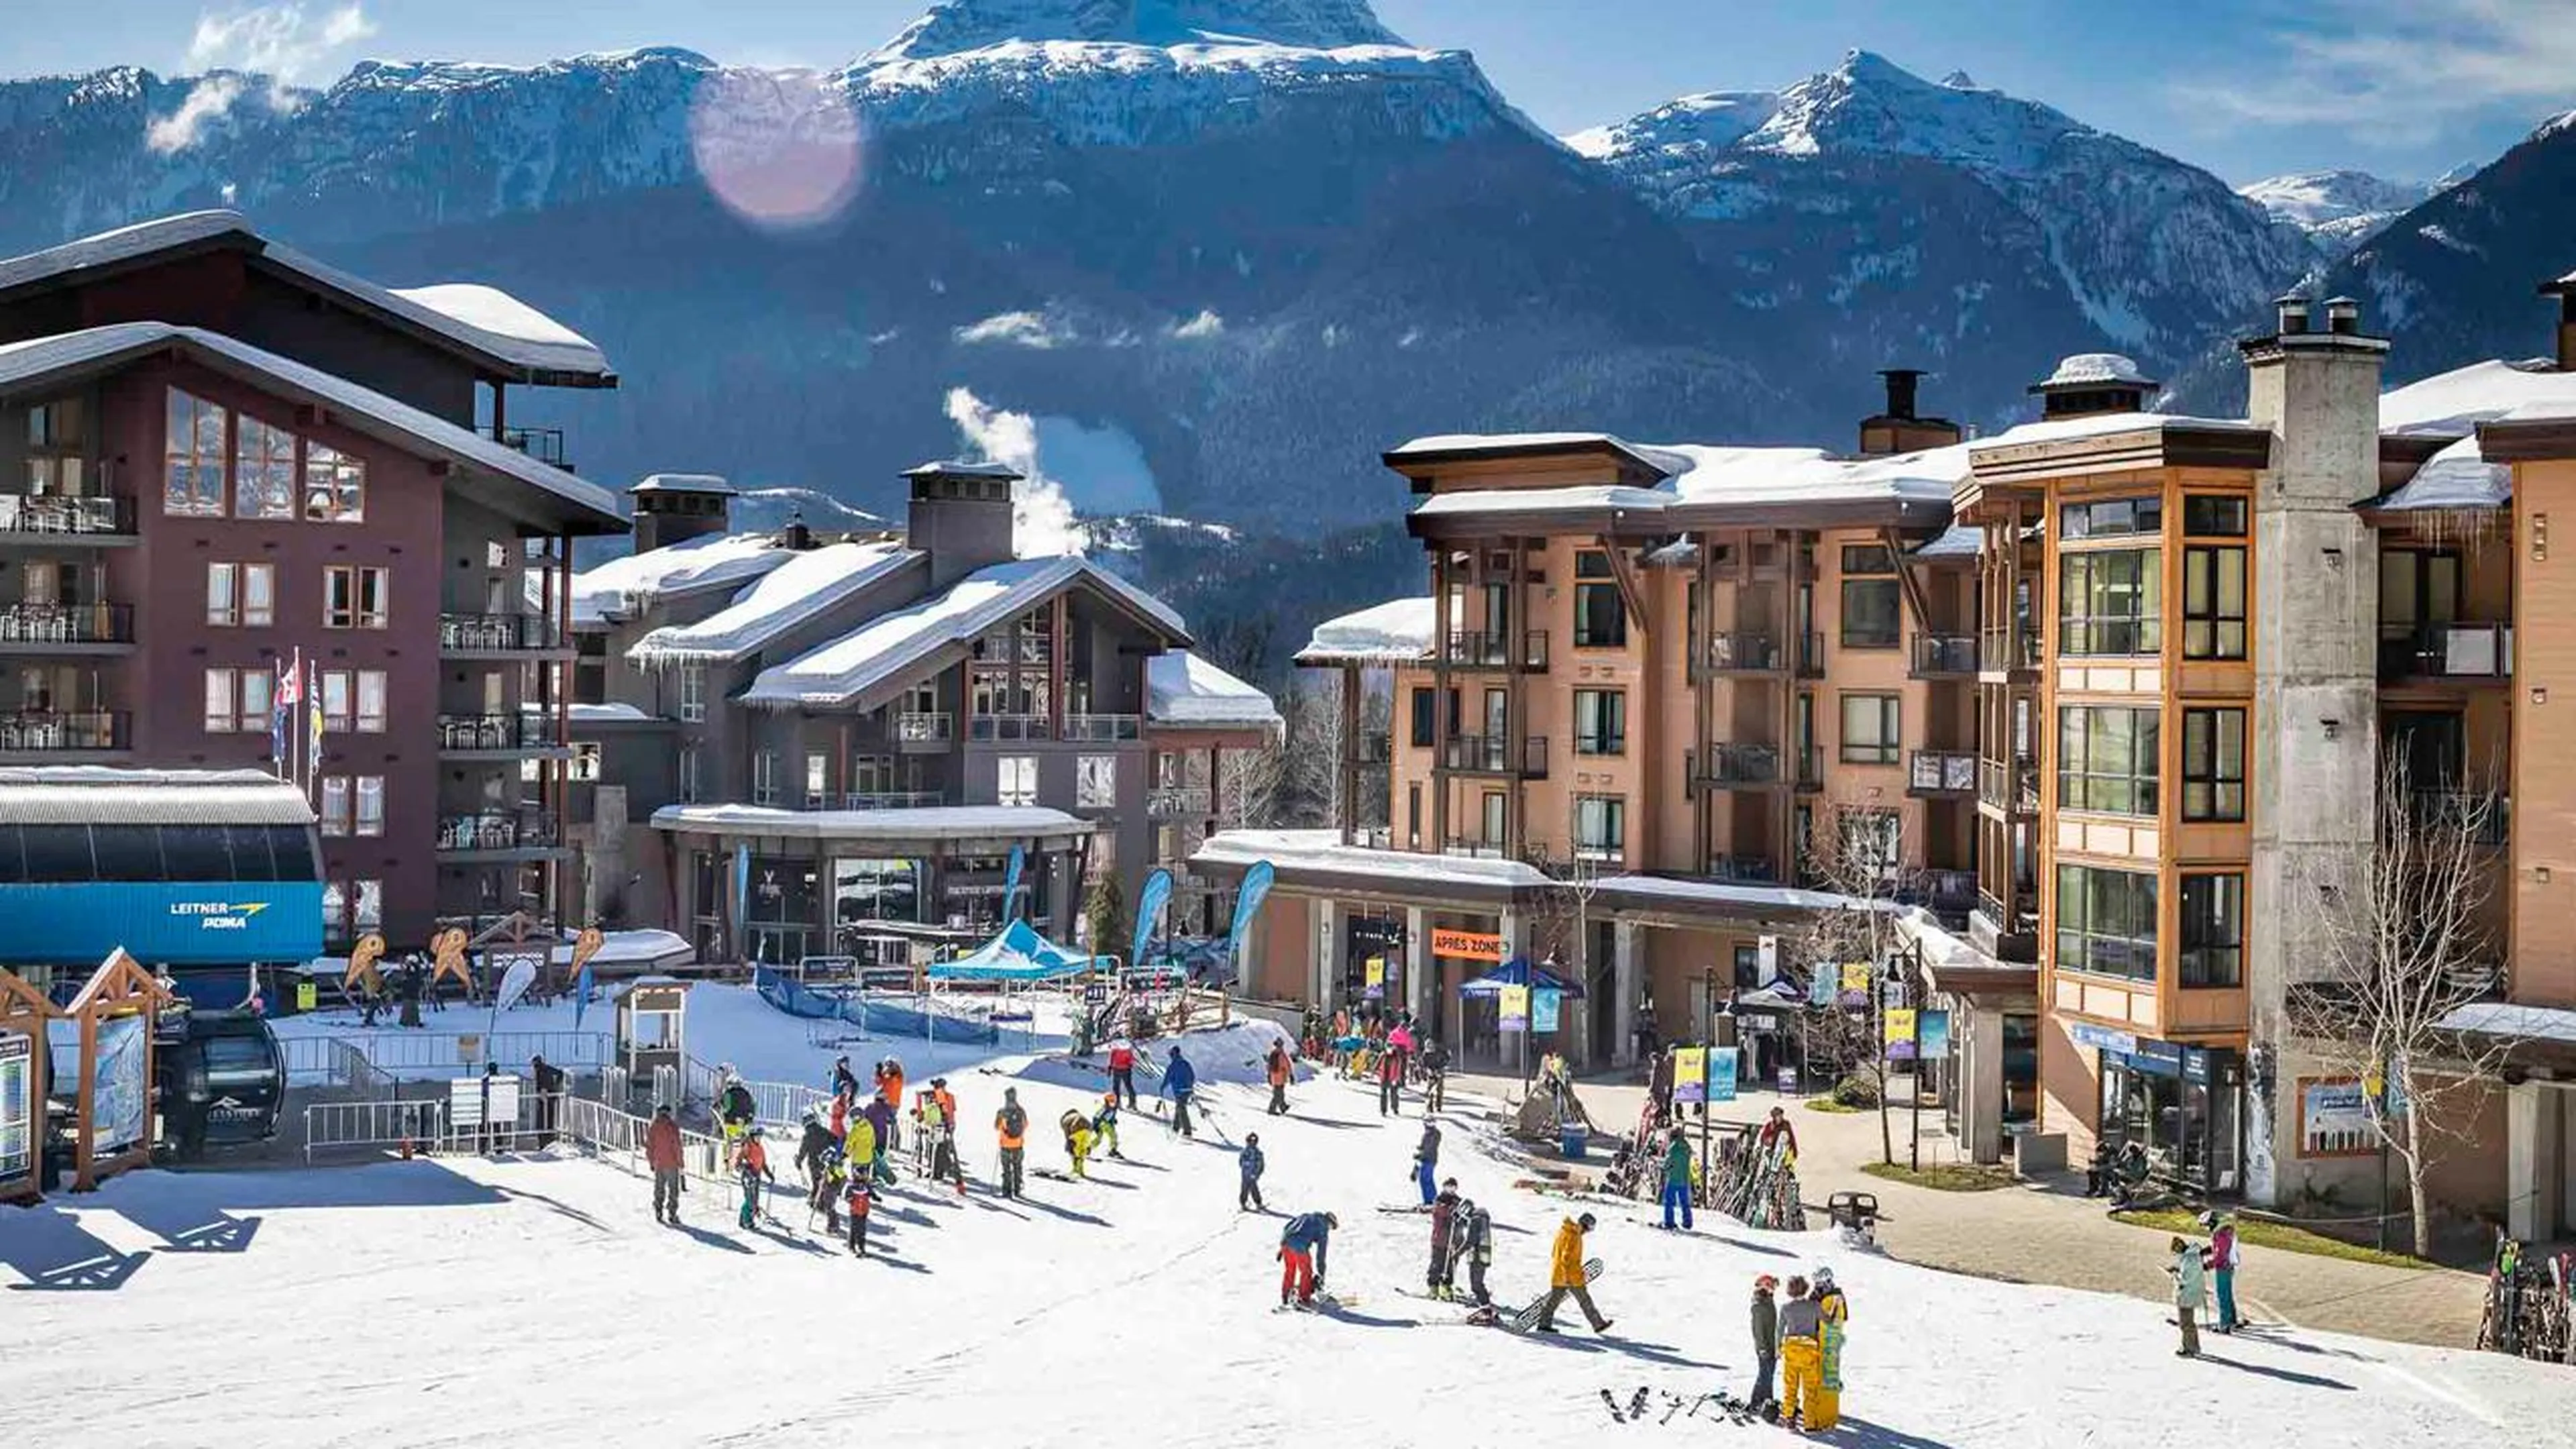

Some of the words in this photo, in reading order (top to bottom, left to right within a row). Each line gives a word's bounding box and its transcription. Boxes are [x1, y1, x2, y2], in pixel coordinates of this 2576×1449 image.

[170, 902, 228, 914] LEITNER
[203, 917, 246, 928] POMA
[1470, 939, 1501, 954] ZONE
